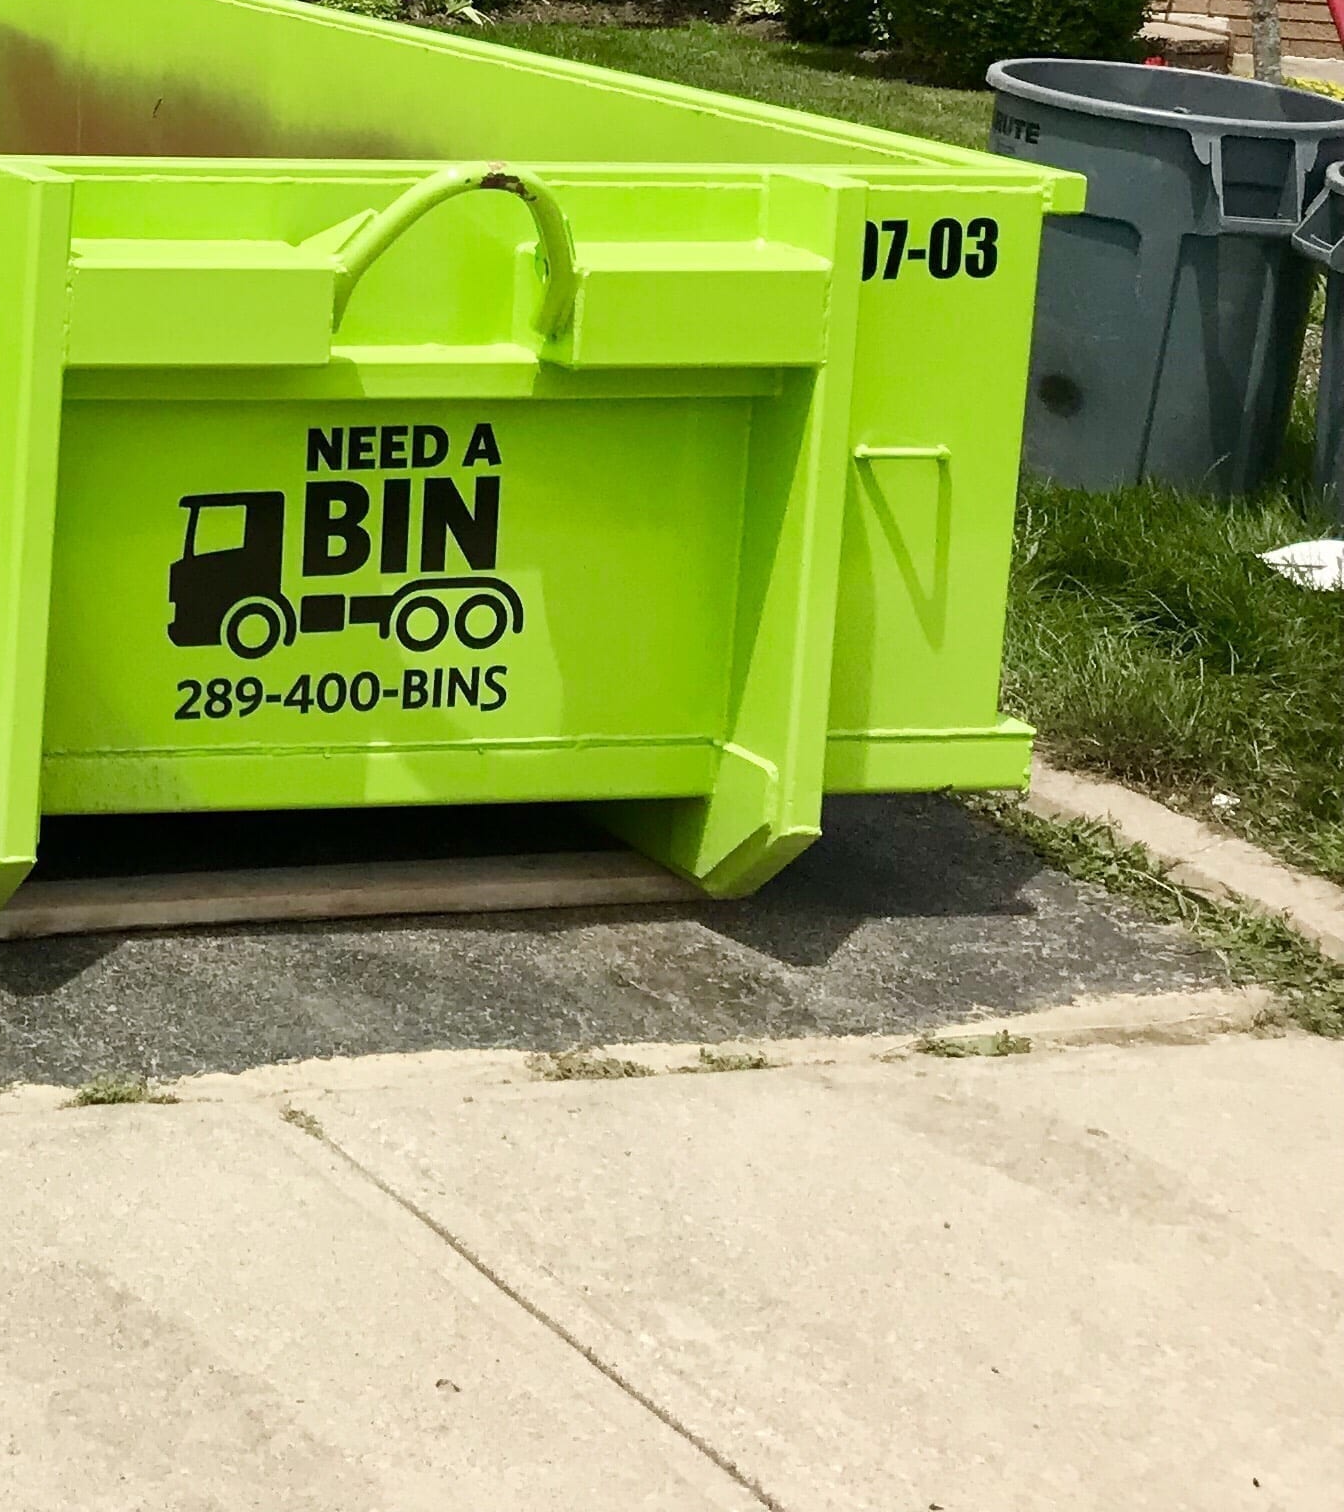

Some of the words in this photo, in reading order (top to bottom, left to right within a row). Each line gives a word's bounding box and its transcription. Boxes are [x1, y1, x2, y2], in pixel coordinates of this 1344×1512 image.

[306, 424, 450, 472] NEED
[462, 423, 502, 467] A
[302, 476, 501, 577] BIN
[174, 665, 508, 720] 289-400-BINS
